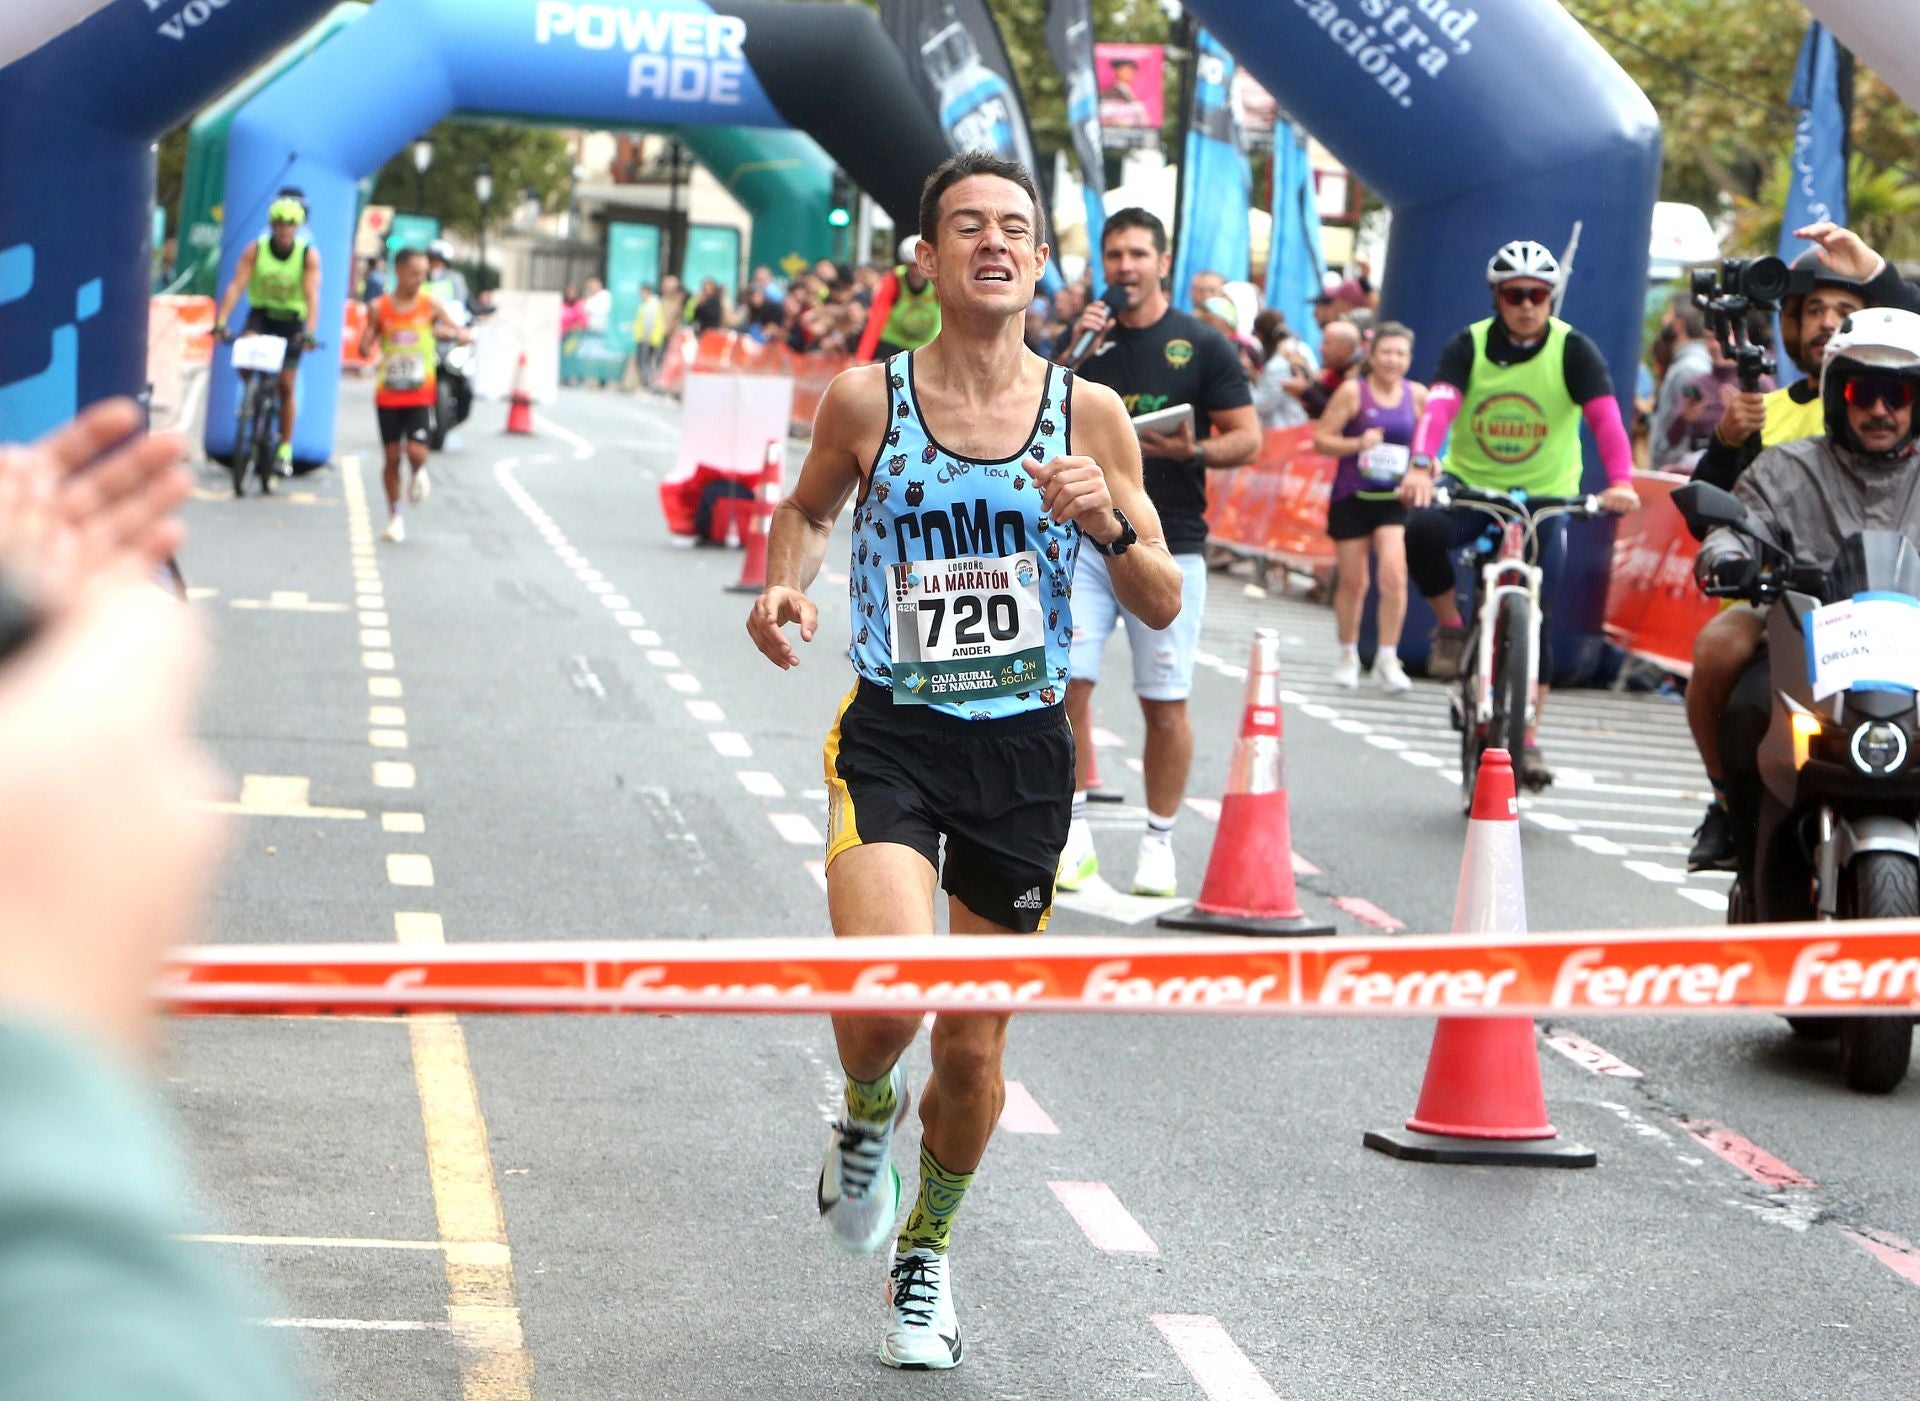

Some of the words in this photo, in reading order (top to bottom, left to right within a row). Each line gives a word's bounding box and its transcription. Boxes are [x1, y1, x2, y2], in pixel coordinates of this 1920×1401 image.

[535, 2, 747, 59] POWER
[1294, 0, 1412, 108] ación.
[626, 53, 745, 105] ADE
[937, 460, 975, 484] CAB
[983, 467, 1010, 479] LOCA
[894, 499, 1026, 562] COMO
[947, 560, 984, 572] LOGROÑO
[923, 575, 941, 594] LA
[945, 570, 1009, 592] MARATÓN
[897, 604, 916, 613] 42K
[918, 594, 1020, 648] 720
[952, 646, 991, 657] ANDER
[931, 672, 957, 684] CAJA
[957, 670, 994, 682] RURAL
[1001, 661, 1036, 676] ACÓN
[931, 683, 947, 694] DE
[949, 678, 998, 692] NAVARRA
[1001, 672, 1037, 686] SOCIAL
[1013, 899, 1043, 909] adidas
[1320, 955, 1518, 1007] ferrer
[1551, 948, 1753, 1008] ferrer
[1784, 940, 1920, 1008] ferr
